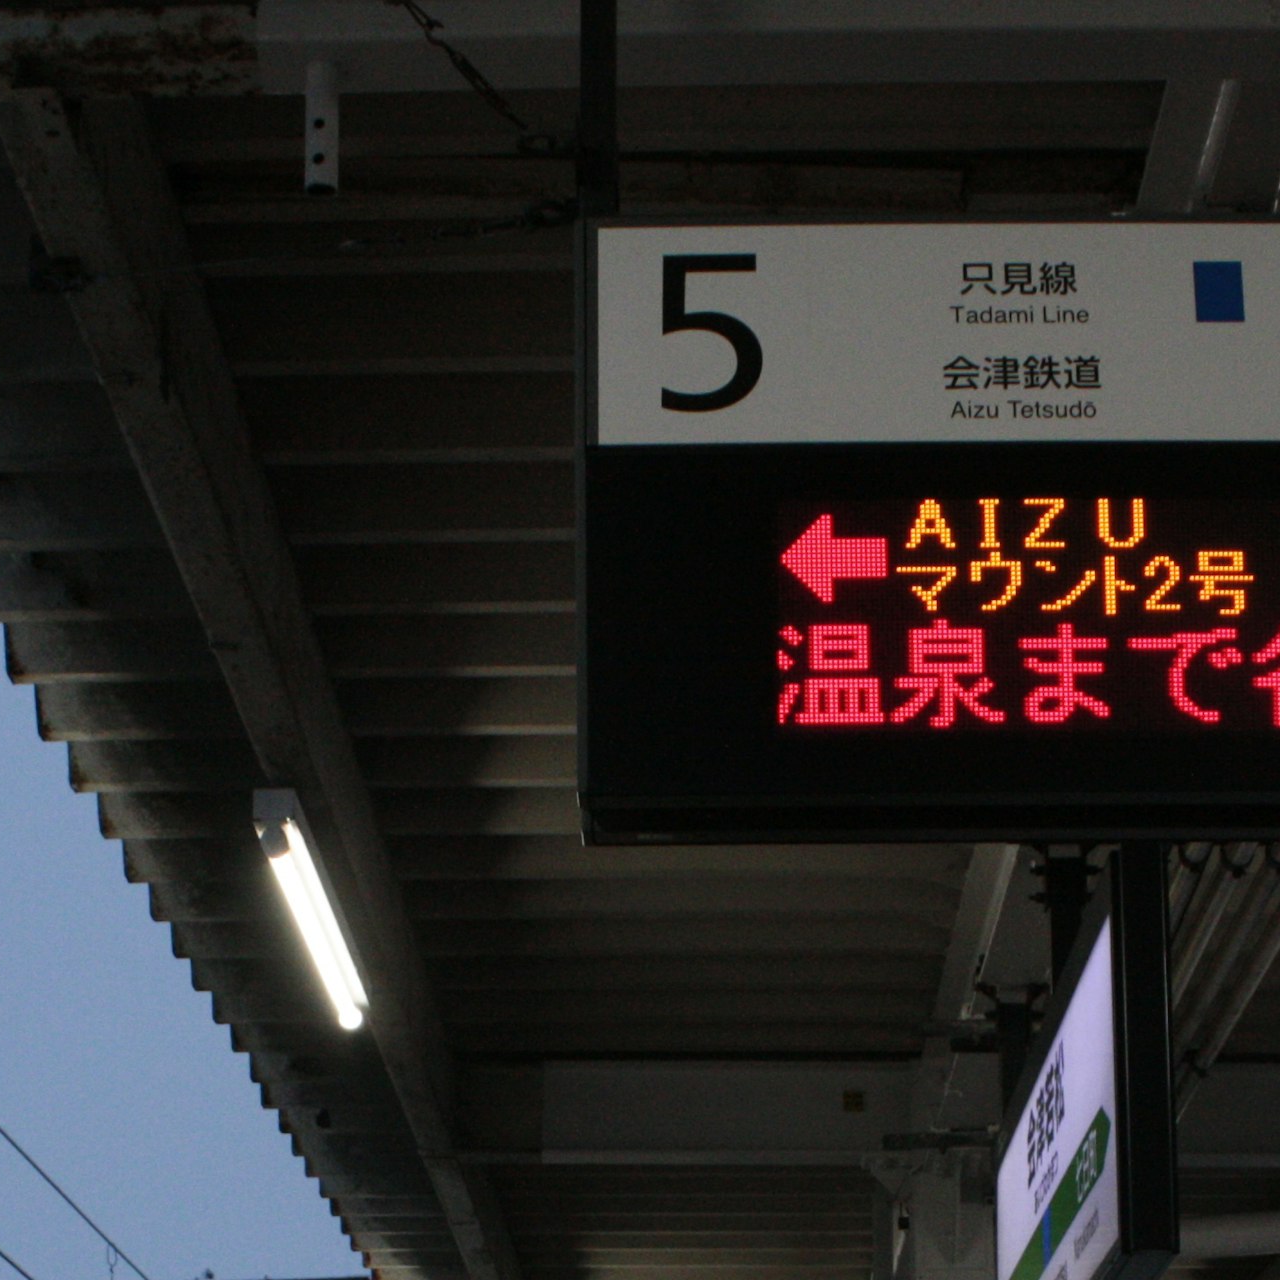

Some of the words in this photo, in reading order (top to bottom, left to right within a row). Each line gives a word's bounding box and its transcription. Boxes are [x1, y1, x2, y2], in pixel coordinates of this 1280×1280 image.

[961, 261, 1077, 297] 只見線
[950, 304, 1035, 324] Tadami
[1043, 304, 1089, 324] Line
[661, 253, 763, 412] 5
[943, 354, 1102, 391] 会津鉄道
[950, 402, 999, 420] Aizu
[1002, 400, 1096, 420] Tetsudō
[897, 552, 1254, 615] マウント2号
